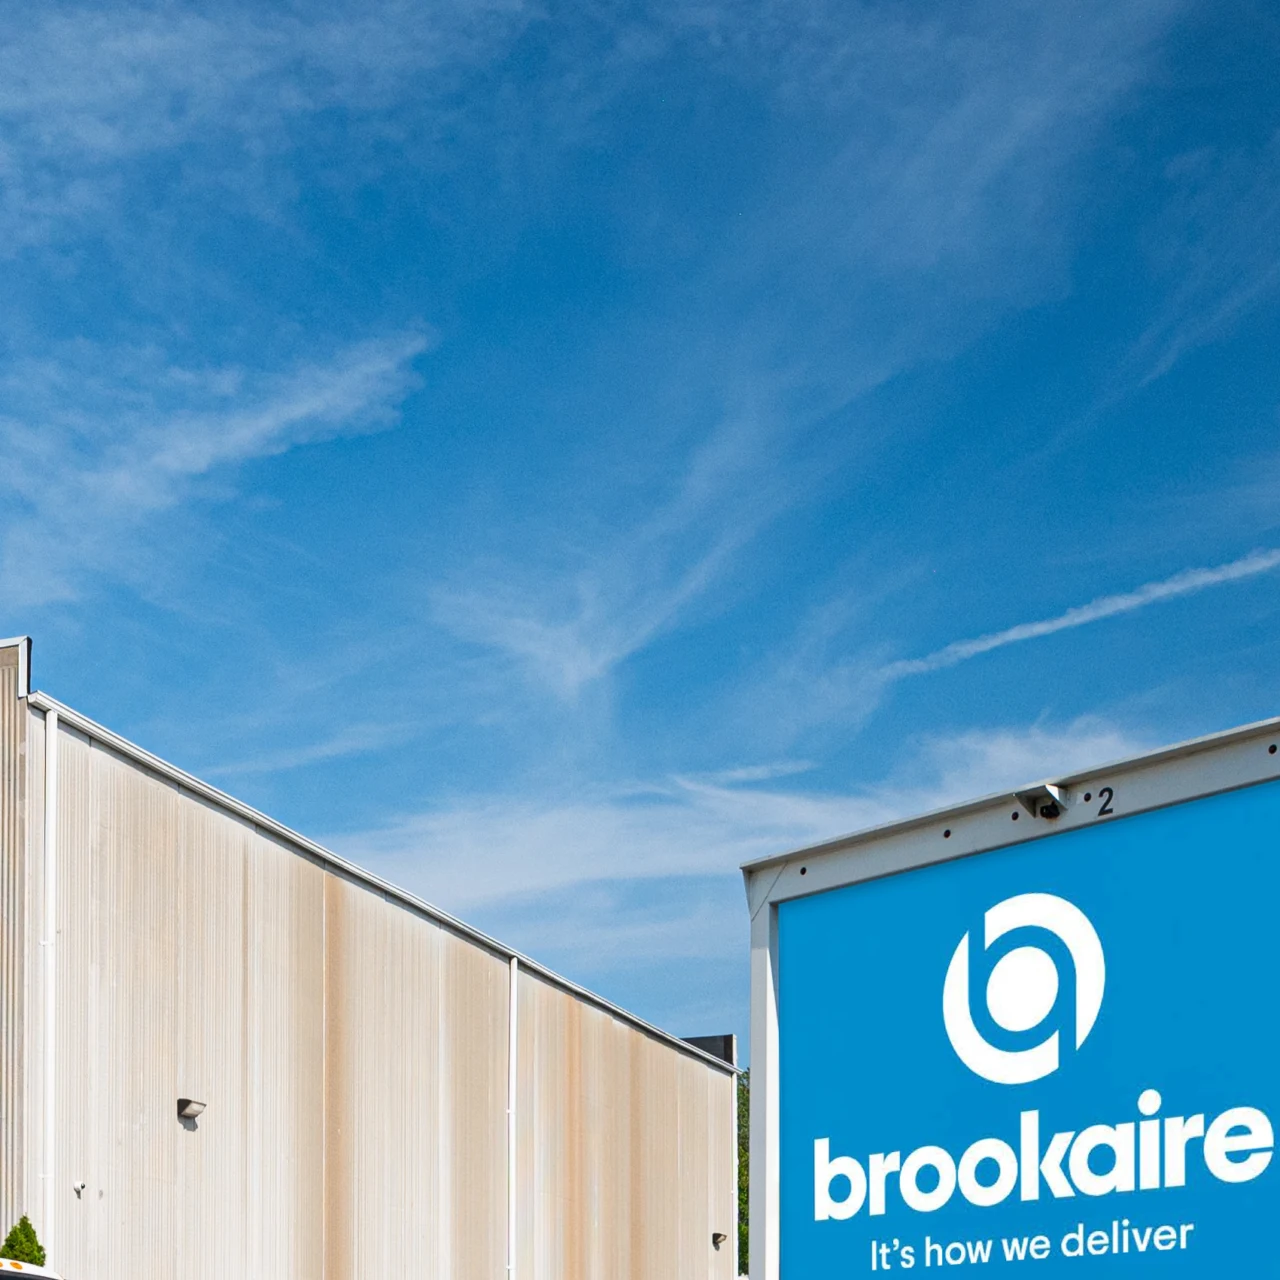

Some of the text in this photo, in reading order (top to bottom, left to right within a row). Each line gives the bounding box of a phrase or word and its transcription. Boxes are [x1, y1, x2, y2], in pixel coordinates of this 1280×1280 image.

[1097, 787, 1114, 816] 2
[814, 1089, 1274, 1221] brookaire
[872, 1219, 1194, 1270] It's how we deliver
